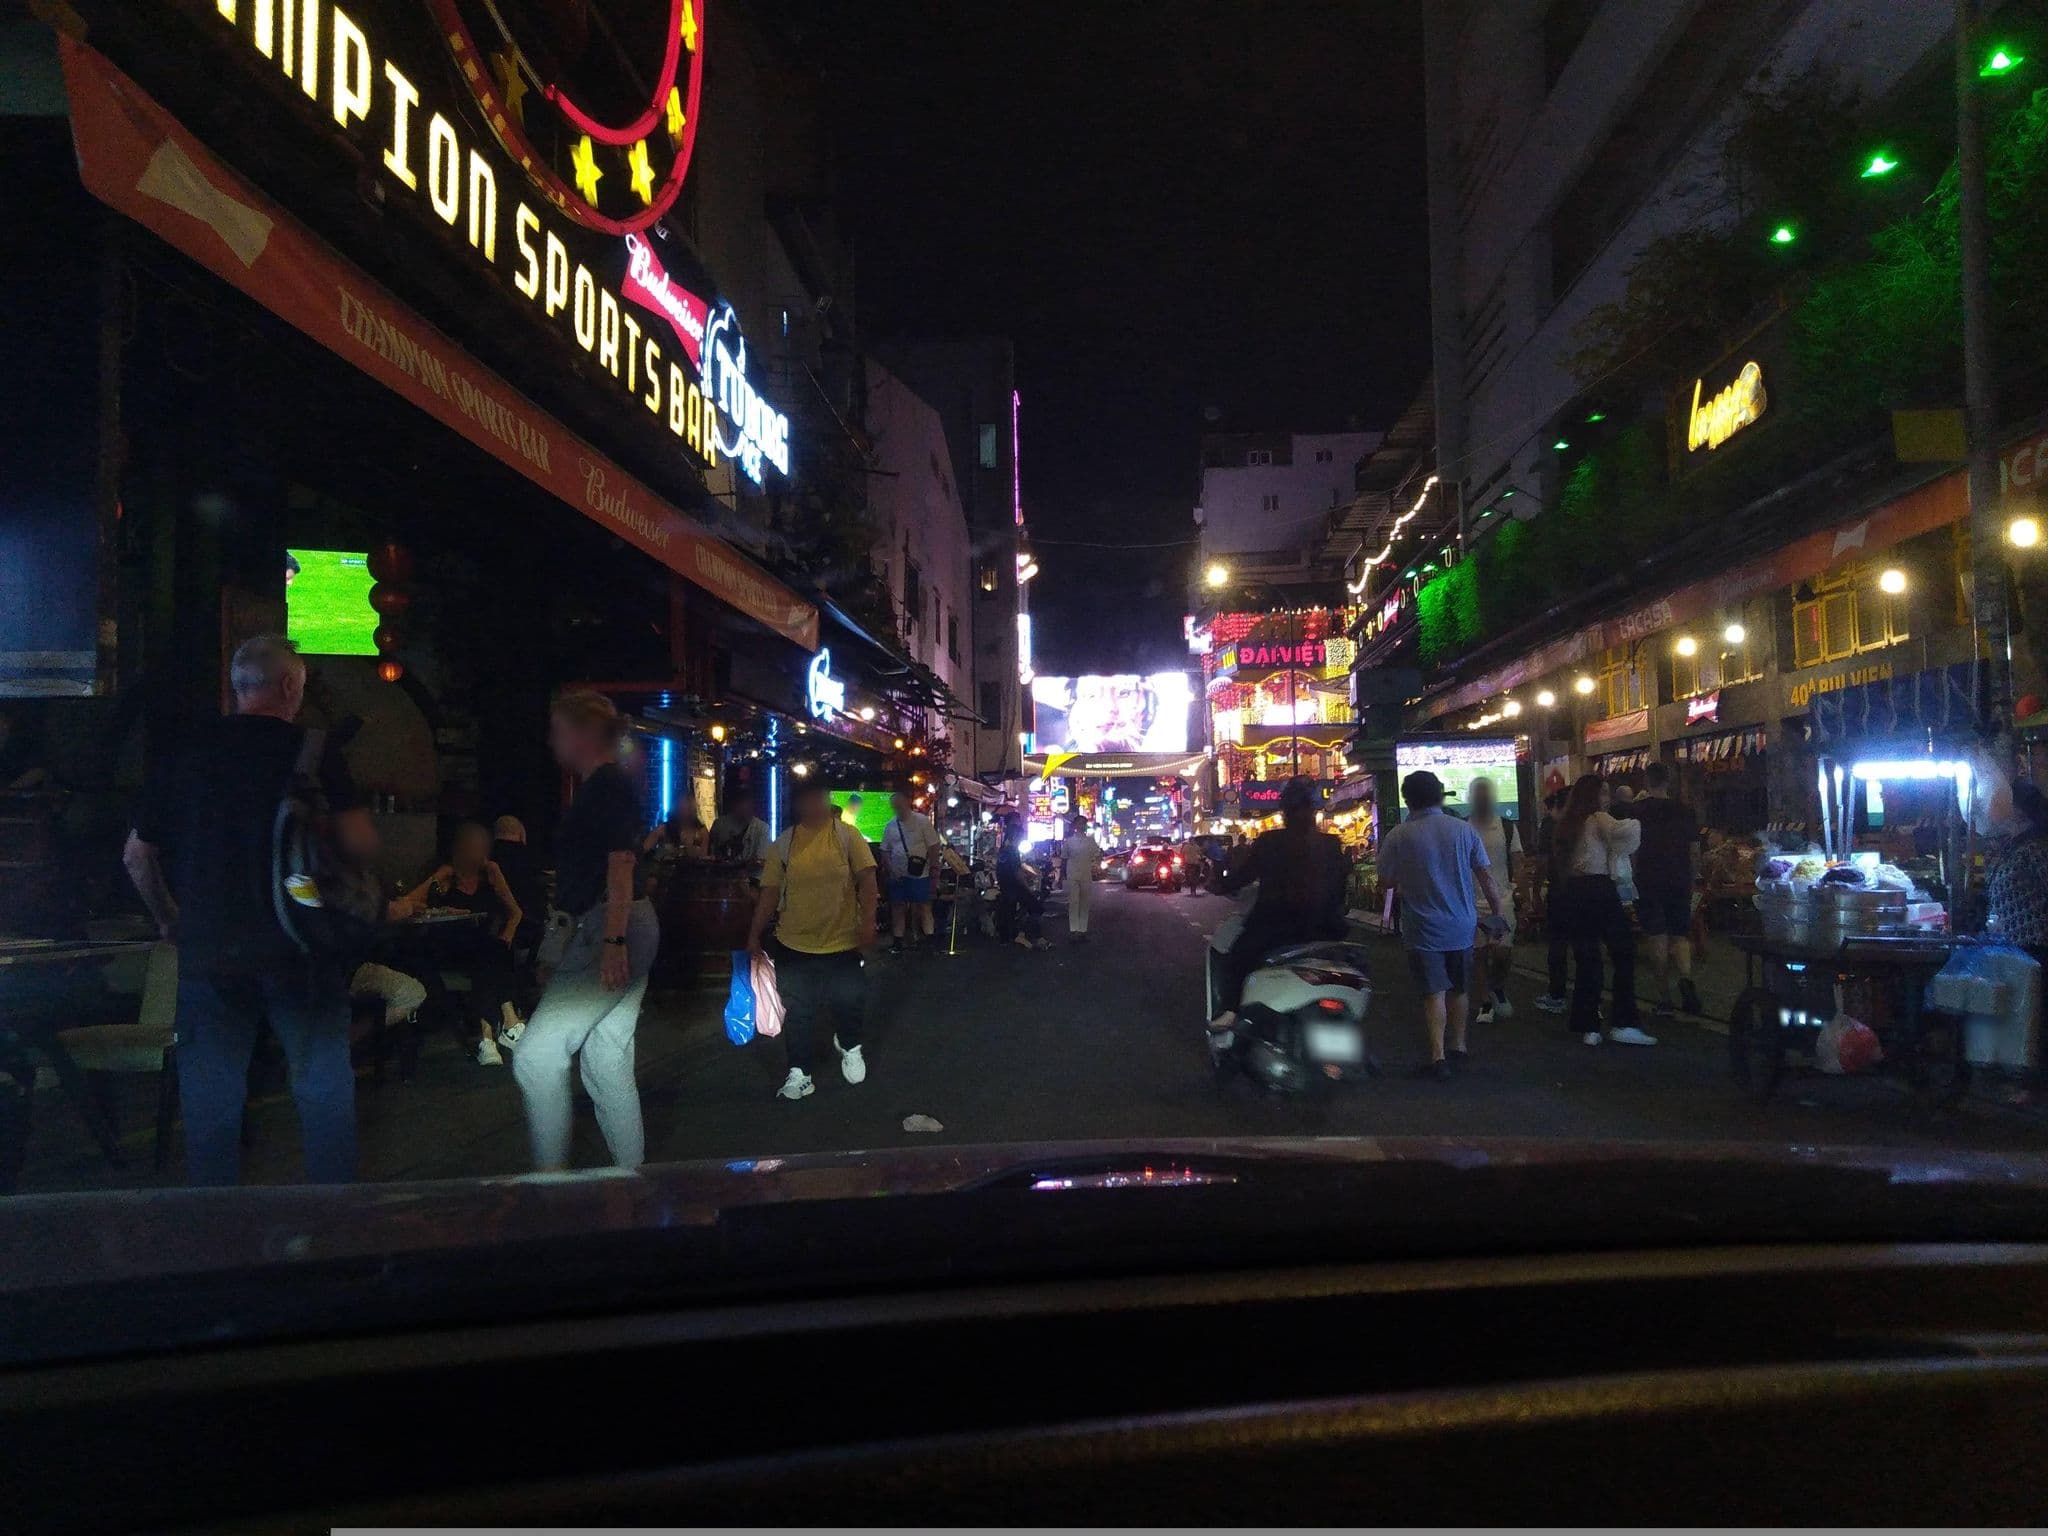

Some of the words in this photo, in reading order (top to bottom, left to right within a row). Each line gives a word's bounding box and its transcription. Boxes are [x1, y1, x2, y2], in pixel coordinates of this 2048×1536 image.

[514, 200, 662, 416] SPORTS
[669, 361, 718, 468] BAR
[625, 233, 705, 342] Budweiser
[518, 418, 553, 475] BAR
[578, 457, 672, 551] Budweiser
